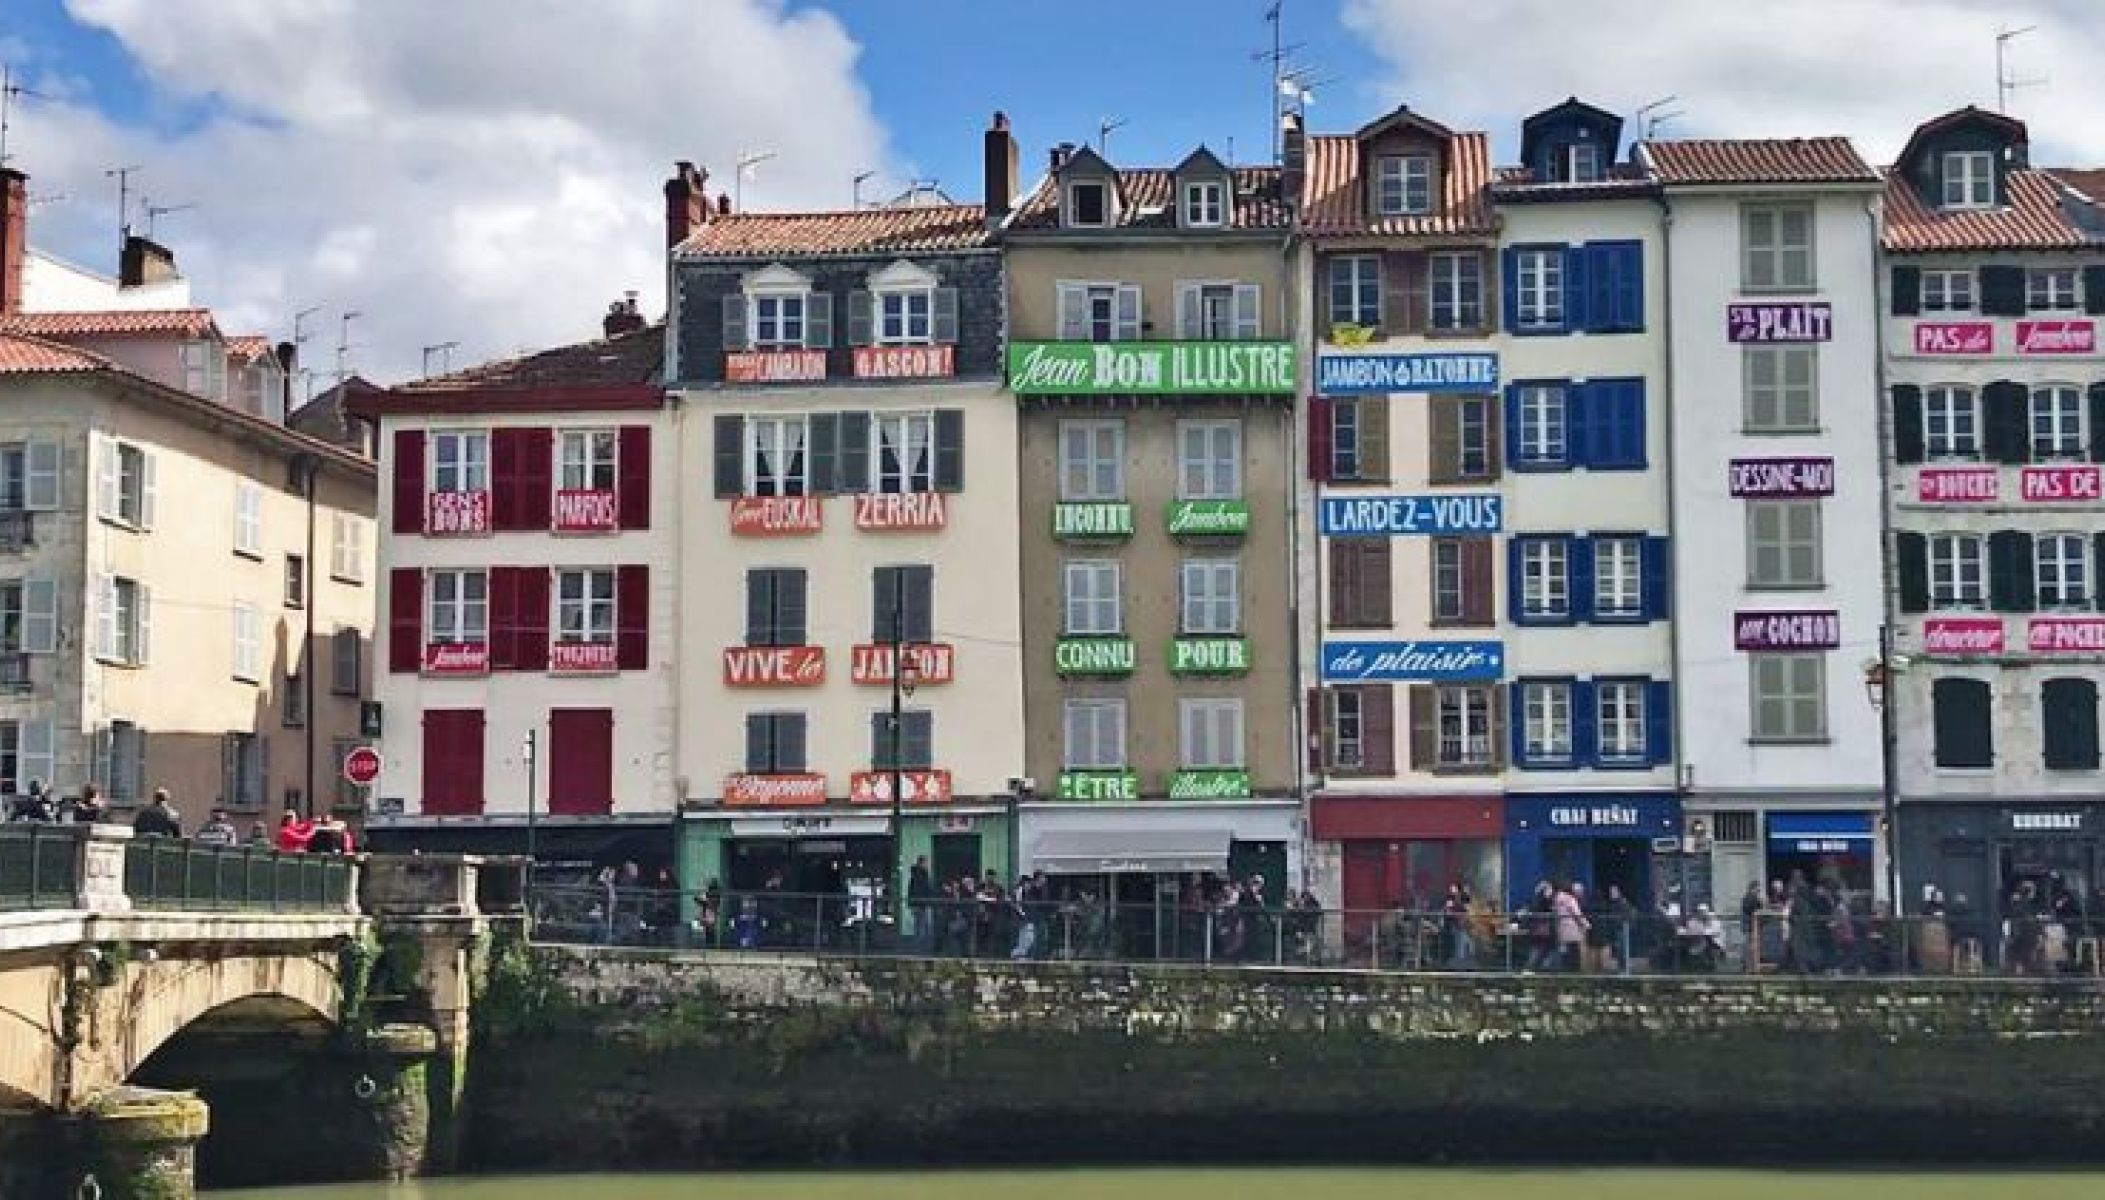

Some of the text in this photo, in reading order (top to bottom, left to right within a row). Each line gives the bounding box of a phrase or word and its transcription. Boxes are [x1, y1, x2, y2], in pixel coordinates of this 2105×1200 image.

[1921, 327, 1961, 350] PAS
[1010, 345, 1088, 390] Jean
[1172, 346, 1294, 388] ILLUSTRE
[1323, 358, 1393, 387] JAMBON
[1732, 464, 1833, 493] DESSINE-MOI
[2026, 472, 2099, 497] PAS DE
[558, 494, 613, 526] PARFOIS
[857, 493, 944, 526] ZERRIA
[1329, 498, 1498, 532] LARDEZ-VOUS
[1768, 615, 1838, 644] COCHON
[726, 650, 792, 681] VIVE
[1056, 641, 1134, 667] CONNU
[1175, 641, 1246, 667] POUR
[1329, 649, 1365, 671] de
[350, 760, 376, 773] STOP
